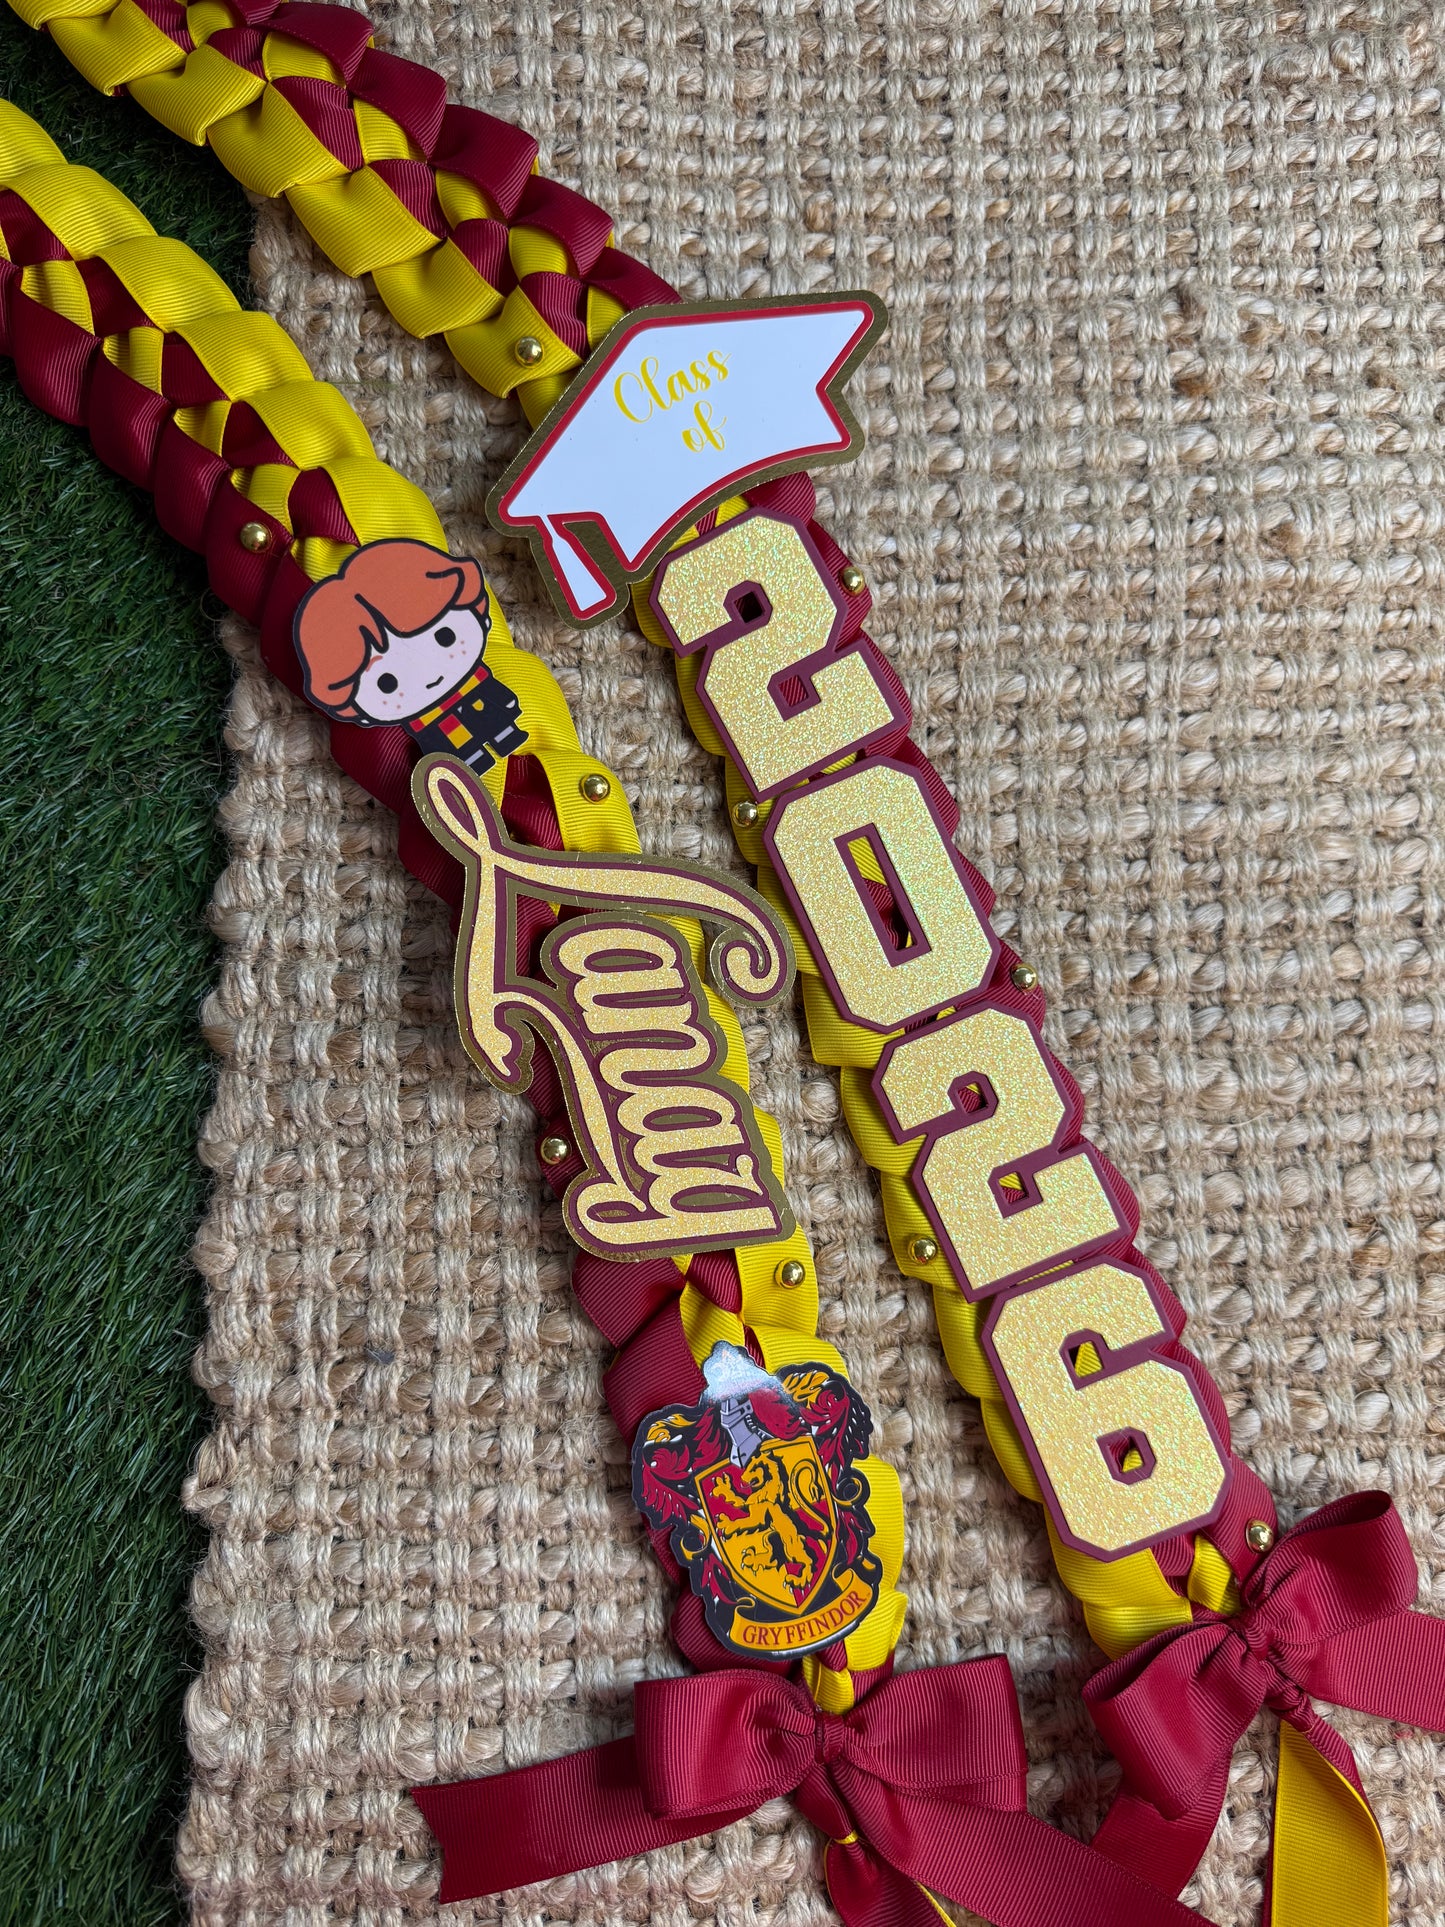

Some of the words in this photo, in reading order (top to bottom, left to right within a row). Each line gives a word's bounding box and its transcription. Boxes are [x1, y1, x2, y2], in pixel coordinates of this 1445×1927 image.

[613, 349, 732, 425] Class
[681, 399, 728, 453] of
[424, 762, 791, 1250] Lanay
[653, 511, 1231, 1558] 2026
[742, 1590, 867, 1646] GRYFFINDOR
